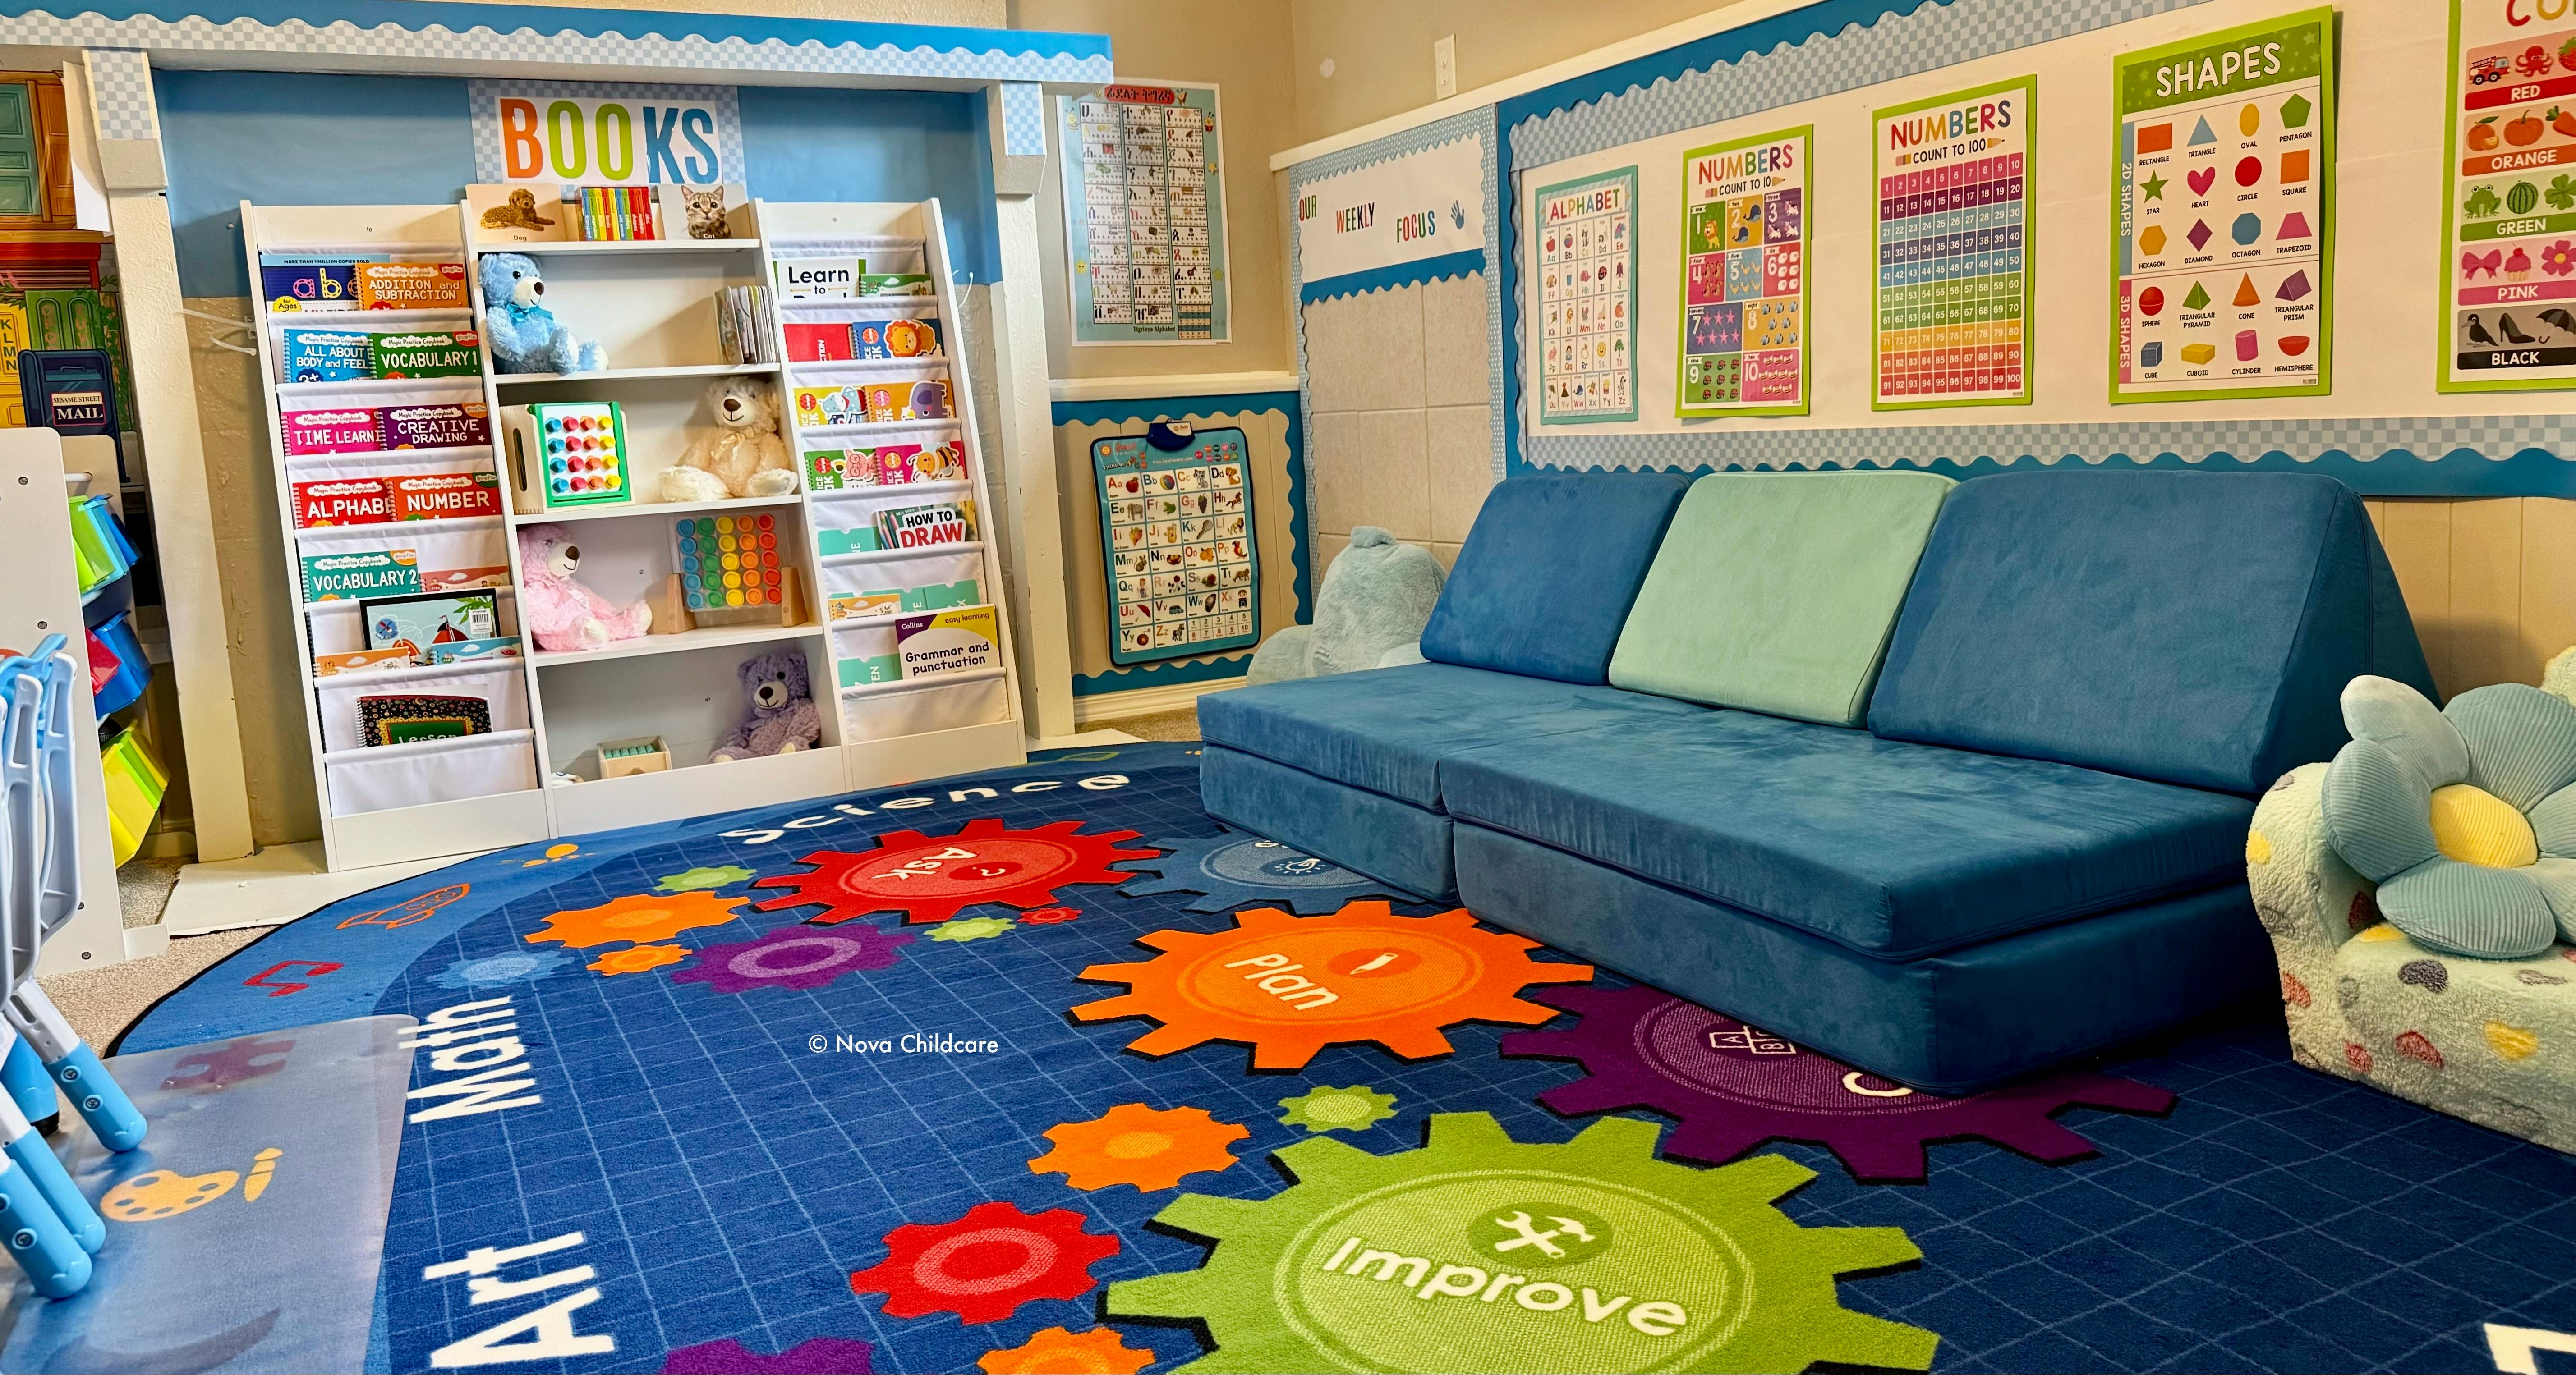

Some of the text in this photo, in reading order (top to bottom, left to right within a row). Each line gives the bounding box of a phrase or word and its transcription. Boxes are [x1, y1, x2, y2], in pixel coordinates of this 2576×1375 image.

[2156, 42, 2281, 97] SHAPES
[2511, 85, 2541, 101] RED
[1891, 100, 2011, 150] NUMBERS
[500, 98, 719, 184] BOOKS
[2241, 141, 2257, 149] OVAL
[2279, 131, 2312, 142] PENTAGON
[1913, 138, 1986, 164] COUNT TO 100
[2188, 147, 2216, 158] TRIANGLE
[2491, 149, 2557, 170] ORANGE
[1699, 144, 1793, 184] NUMBERS
[2139, 156, 2170, 166] RECTANGLE
[1898, 180, 1903, 189] 2
[1912, 179, 1916, 187] 3
[1925, 176, 1930, 185] 4
[1940, 173, 1944, 182] 5
[1954, 170, 1959, 180] 6
[1968, 169, 1973, 177] 7
[1983, 165, 1988, 174] 8
[1997, 163, 2003, 172] 9
[2011, 160, 2019, 170] 10
[1719, 176, 1771, 195] COUNT TO 10
[2282, 187, 2307, 196] SQUARE
[1550, 188, 1620, 221] ALPHABET
[2121, 162, 2132, 236] 2D SHAPES
[2191, 200, 2209, 209] HEART
[2237, 193, 2258, 201] CIRCLE
[1299, 195, 1435, 243] OUR WEEKLY FOCUS
[1731, 209, 1740, 228] 2
[1769, 203, 1778, 222] 3
[2497, 218, 2546, 235] GREEN
[2232, 249, 2261, 258] OCTAGON
[2277, 244, 2311, 254] TRAPEZOID
[1768, 256, 1777, 275] 6
[2139, 261, 2165, 269] HEXAGON
[2185, 255, 2213, 264] DIAMOND
[788, 266, 849, 284] Learn
[1692, 265, 1702, 284] 4
[1730, 261, 1739, 280] 5
[369, 280, 460, 289] ADDITION and
[814, 285, 825, 294] to
[2498, 285, 2539, 300] PINK
[375, 290, 456, 300] SUBTRACTION
[2180, 312, 2215, 321] TRIANGULAR
[2275, 304, 2314, 313] TRIANGULAR
[1692, 316, 1701, 335] 7
[1748, 311, 1757, 330] 8
[2120, 296, 2130, 368] 3D SHAPES
[1, 319, 17, 370] K L M N
[304, 346, 364, 358] ALL ABOUT
[296, 357, 324, 367] BODY
[325, 359, 340, 368] and
[381, 351, 477, 368] VOCABULARY 1
[2491, 352, 2540, 366] BLACK
[1690, 366, 1699, 384] 9
[1745, 362, 1759, 381] 10
[2232, 367, 2261, 375] CYLINDER
[2274, 364, 2313, 372] HEMISPHERE
[57, 408, 103, 420] MAIL
[398, 419, 479, 434] CREATIVE
[294, 430, 333, 446] TIME
[412, 432, 467, 444] DRAWING
[1143, 474, 1157, 485] Bb
[1211, 468, 1224, 479] Dd
[1108, 477, 1122, 489] Aa
[407, 491, 490, 512] NUMBER
[906, 511, 952, 528] HOW TO
[900, 522, 963, 548] DRAW
[1115, 554, 1133, 566] Mm
[1151, 550, 1165, 562] Nn
[313, 569, 418, 591] VOCABULARY 2
[1188, 595, 1203, 607] Ww
[962, 613, 989, 621] learning
[906, 641, 989, 662] Grammar and
[913, 656, 985, 676] punctuation
[719, 775, 1130, 845] Science
[871, 847, 977, 880] Ask
[1224, 952, 1340, 1010] Plan
[396, 995, 543, 1124] Math
[1321, 1237, 1689, 1338] Improve
[423, 1230, 616, 1370] Art
